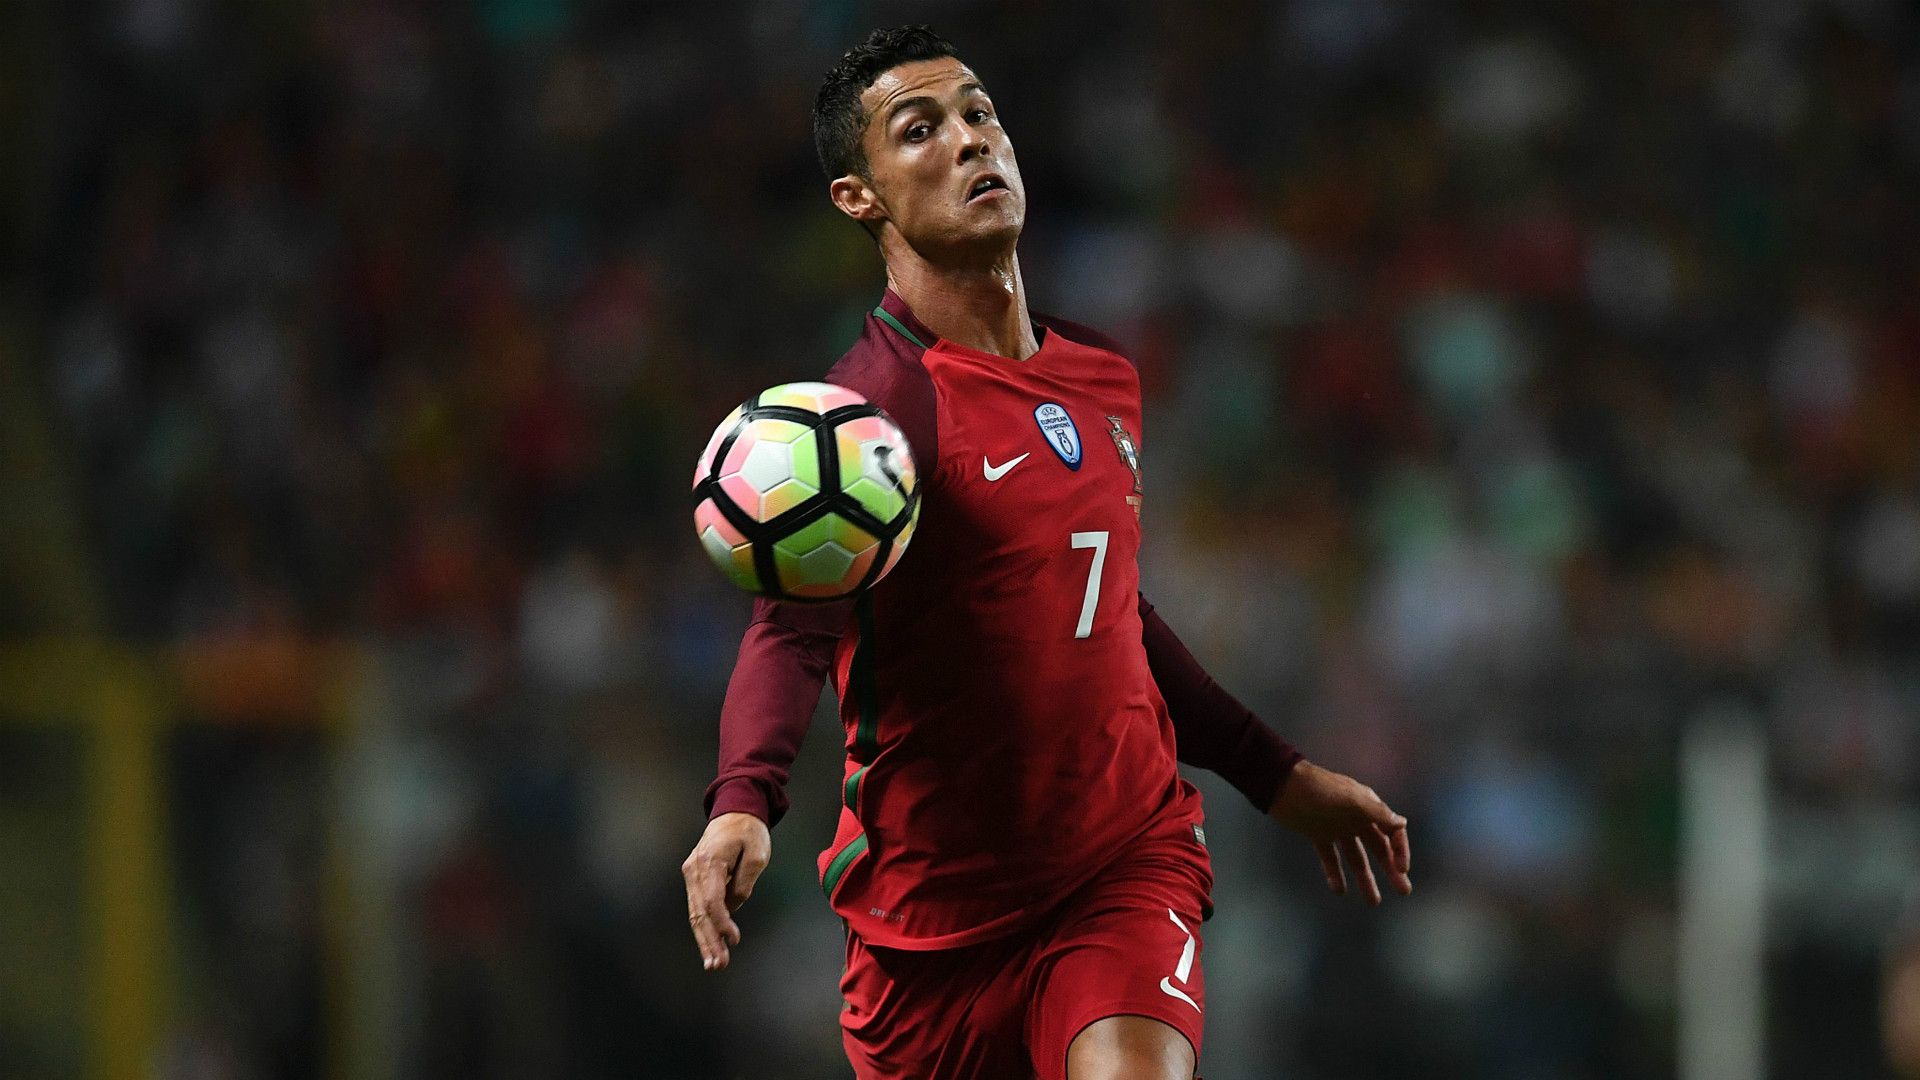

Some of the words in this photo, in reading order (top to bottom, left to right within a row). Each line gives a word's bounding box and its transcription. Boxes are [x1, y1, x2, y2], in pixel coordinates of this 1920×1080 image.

[1040, 416, 1067, 425] EUROPEAN
[1044, 422, 1070, 430] CHAMPIONS
[1071, 531, 1109, 638] 7
[1168, 908, 1196, 984] 7
